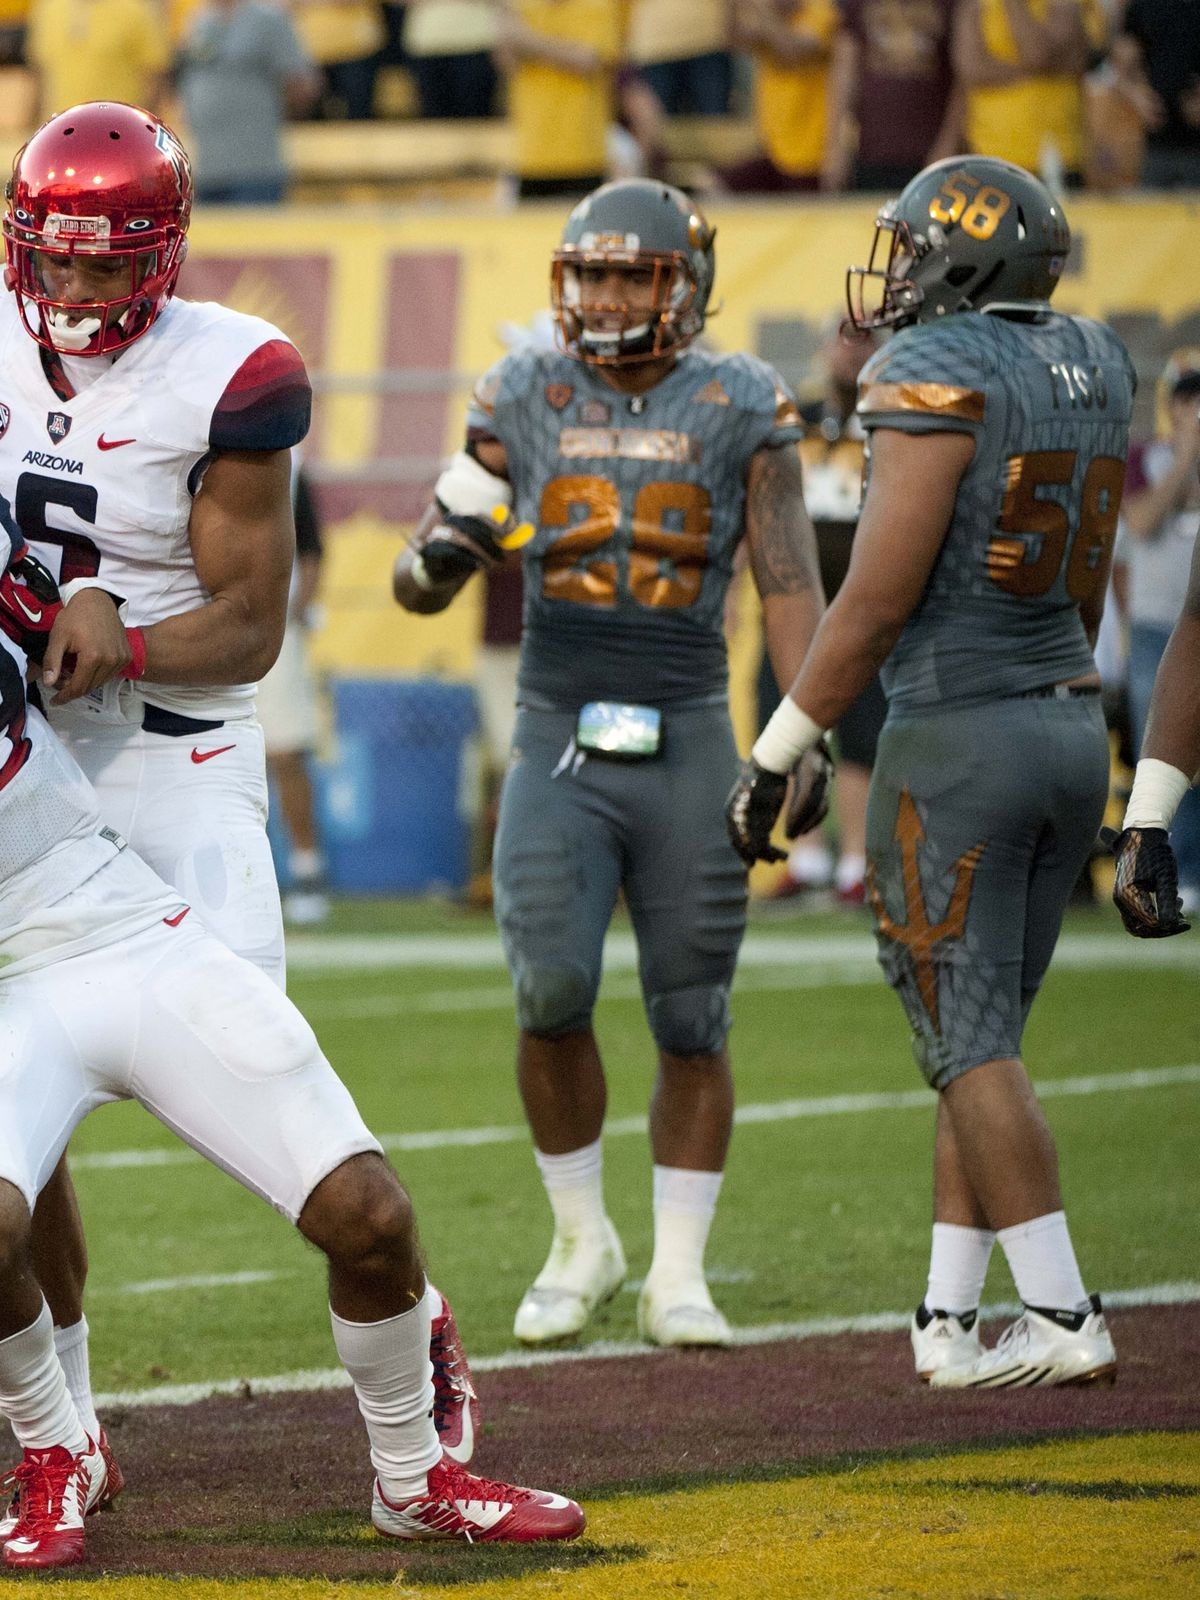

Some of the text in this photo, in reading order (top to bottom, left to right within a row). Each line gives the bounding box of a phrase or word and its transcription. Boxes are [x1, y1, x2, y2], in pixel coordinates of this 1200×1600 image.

[929, 170, 1011, 240] 58
[60, 220, 79, 233] HARD
[48, 415, 66, 436] A
[22, 450, 84, 475] ARIZONA
[984, 449, 1127, 598] 58
